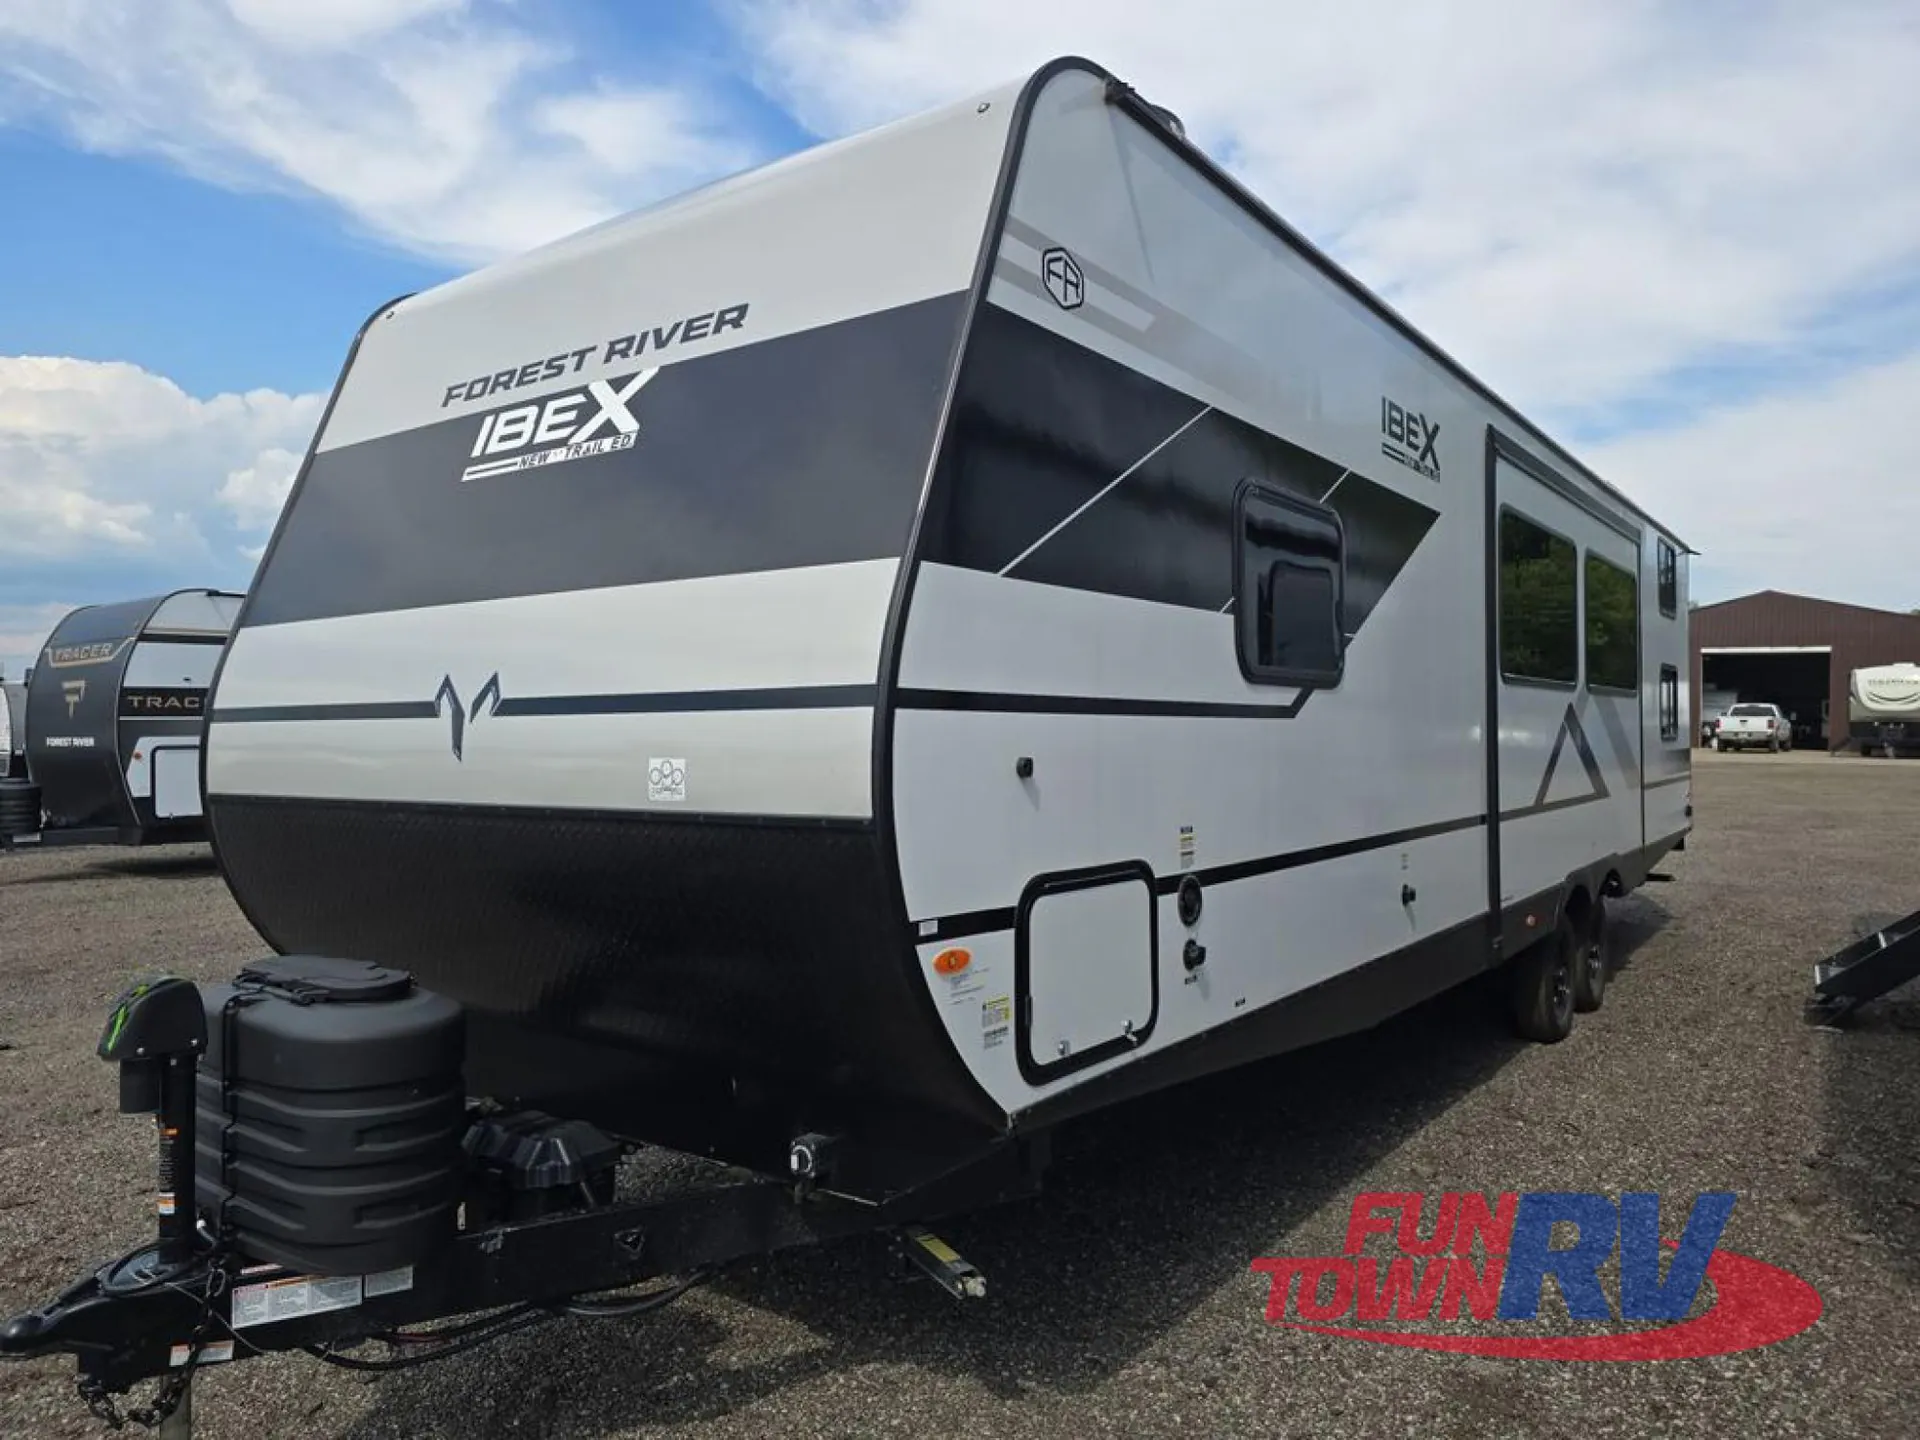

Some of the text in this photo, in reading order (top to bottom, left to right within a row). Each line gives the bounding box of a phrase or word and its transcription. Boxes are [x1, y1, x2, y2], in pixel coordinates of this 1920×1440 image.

[441, 302, 750, 408] FOREST RIVER
[470, 365, 661, 458] IBEX
[1382, 396, 1440, 470] IBEX
